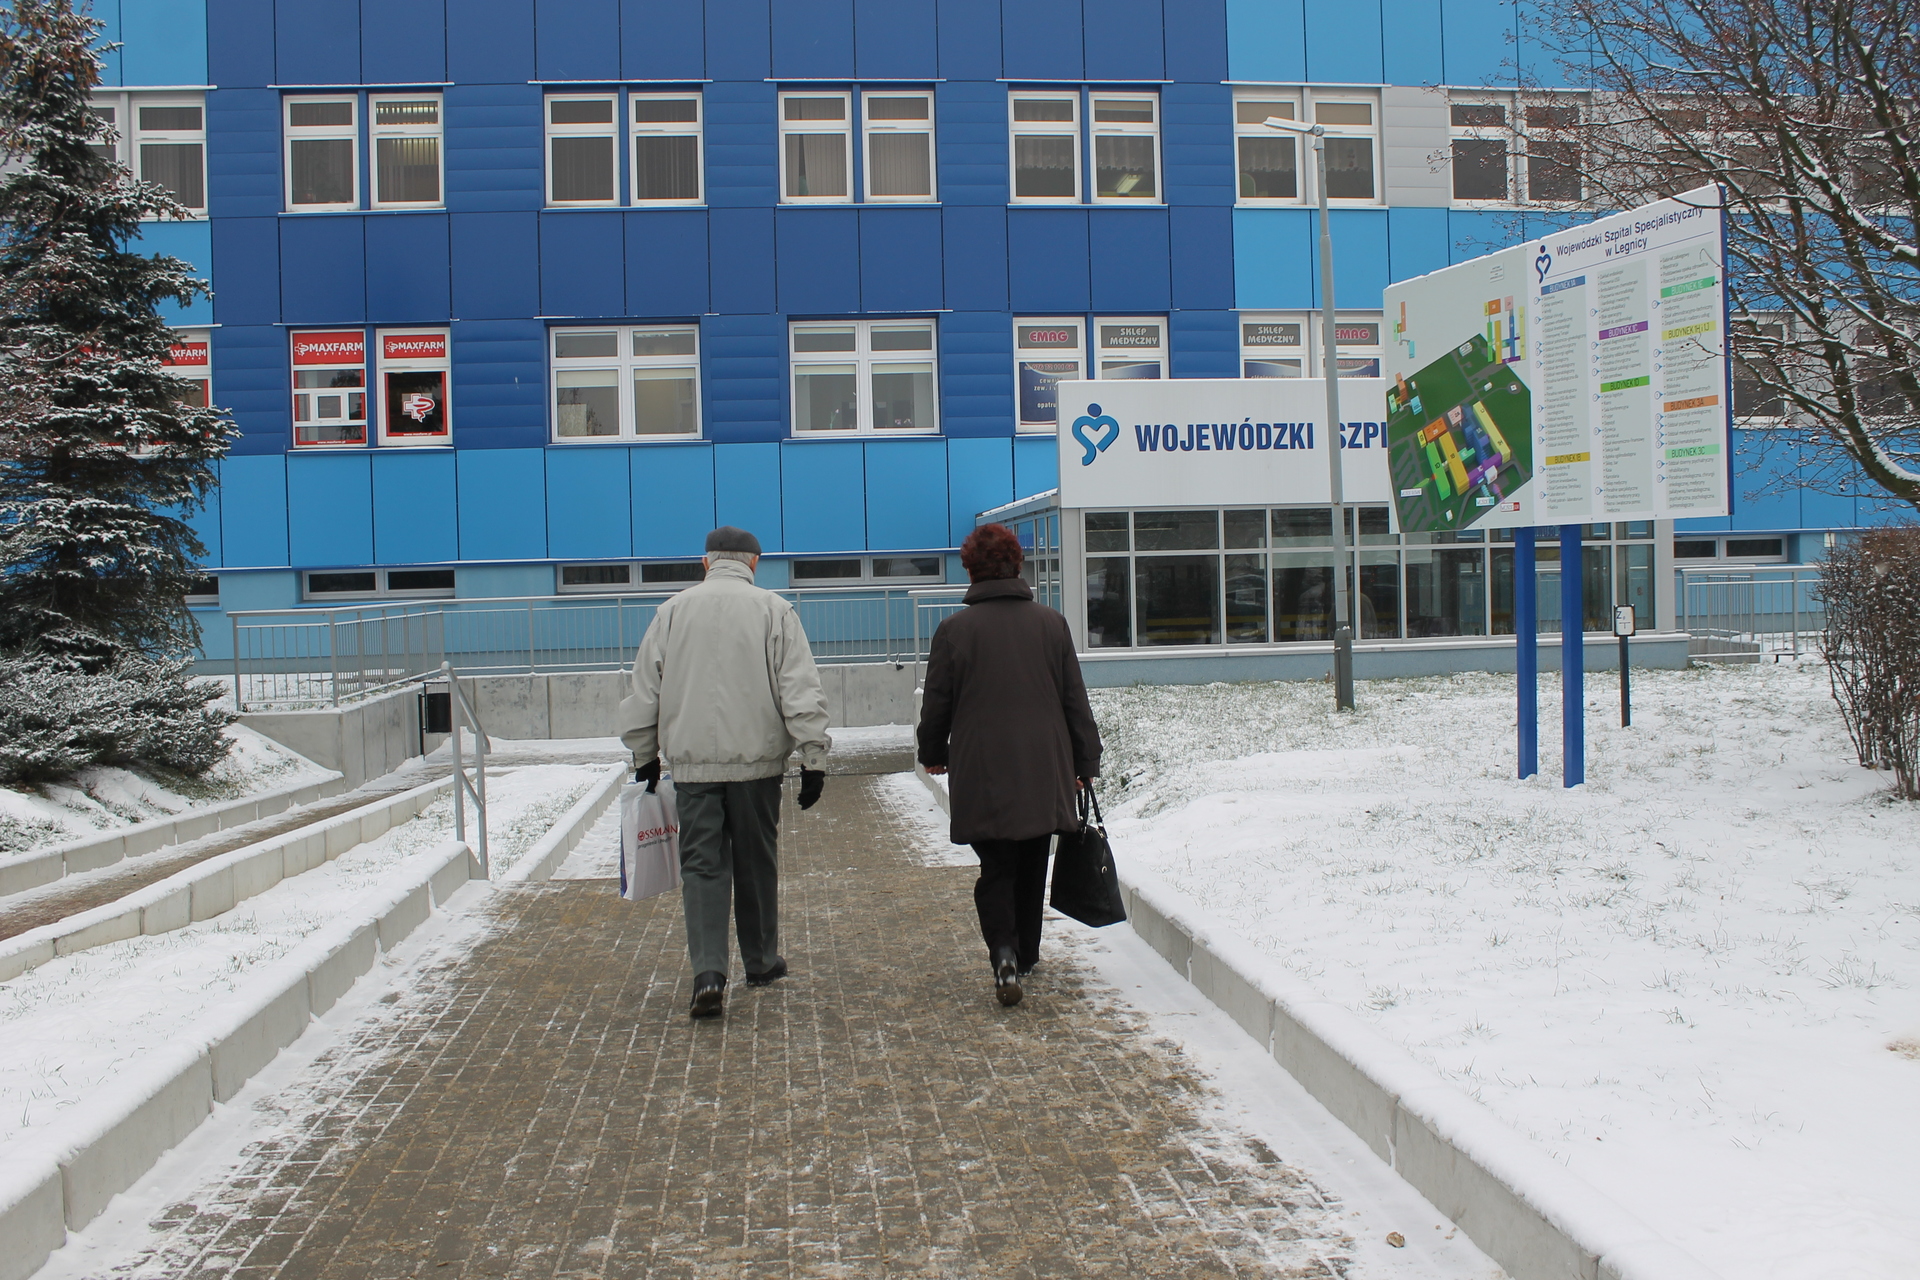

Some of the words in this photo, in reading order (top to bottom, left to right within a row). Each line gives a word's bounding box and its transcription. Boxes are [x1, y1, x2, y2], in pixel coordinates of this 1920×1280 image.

[1556, 233, 1602, 256] Wojewódzki
[1604, 224, 1632, 245] Szpital
[1634, 207, 1704, 235] Specjalistyczny
[1605, 248, 1613, 257] w
[1615, 236, 1648, 256] Legnicy
[1671, 282, 1697, 295] BUDYNEK
[1120, 328, 1147, 336] SKLEP
[1257, 326, 1284, 334] SKLEP
[1335, 328, 1370, 339] EMAG
[1609, 326, 1632, 338] BUDYNEK
[1668, 326, 1694, 339] BUDYNEK
[1028, 330, 1069, 343] EMAG
[1110, 337, 1158, 345] MEDYCZNY
[1248, 335, 1295, 343] MEDYCZNY
[309, 342, 363, 352] MAXFARM
[398, 341, 444, 350] MAXFARM
[169, 348, 206, 357] AXFARM
[1610, 379, 1633, 391] BUDYNEK
[1670, 399, 1696, 411] BUDYNEK
[1134, 417, 1314, 452] WOJEWÓDZKI
[1339, 421, 1387, 450] SZPI
[1671, 448, 1697, 458] BUDYNEK
[1554, 454, 1575, 464] BUDYNEK
[638, 824, 679, 841] OSSMANN
